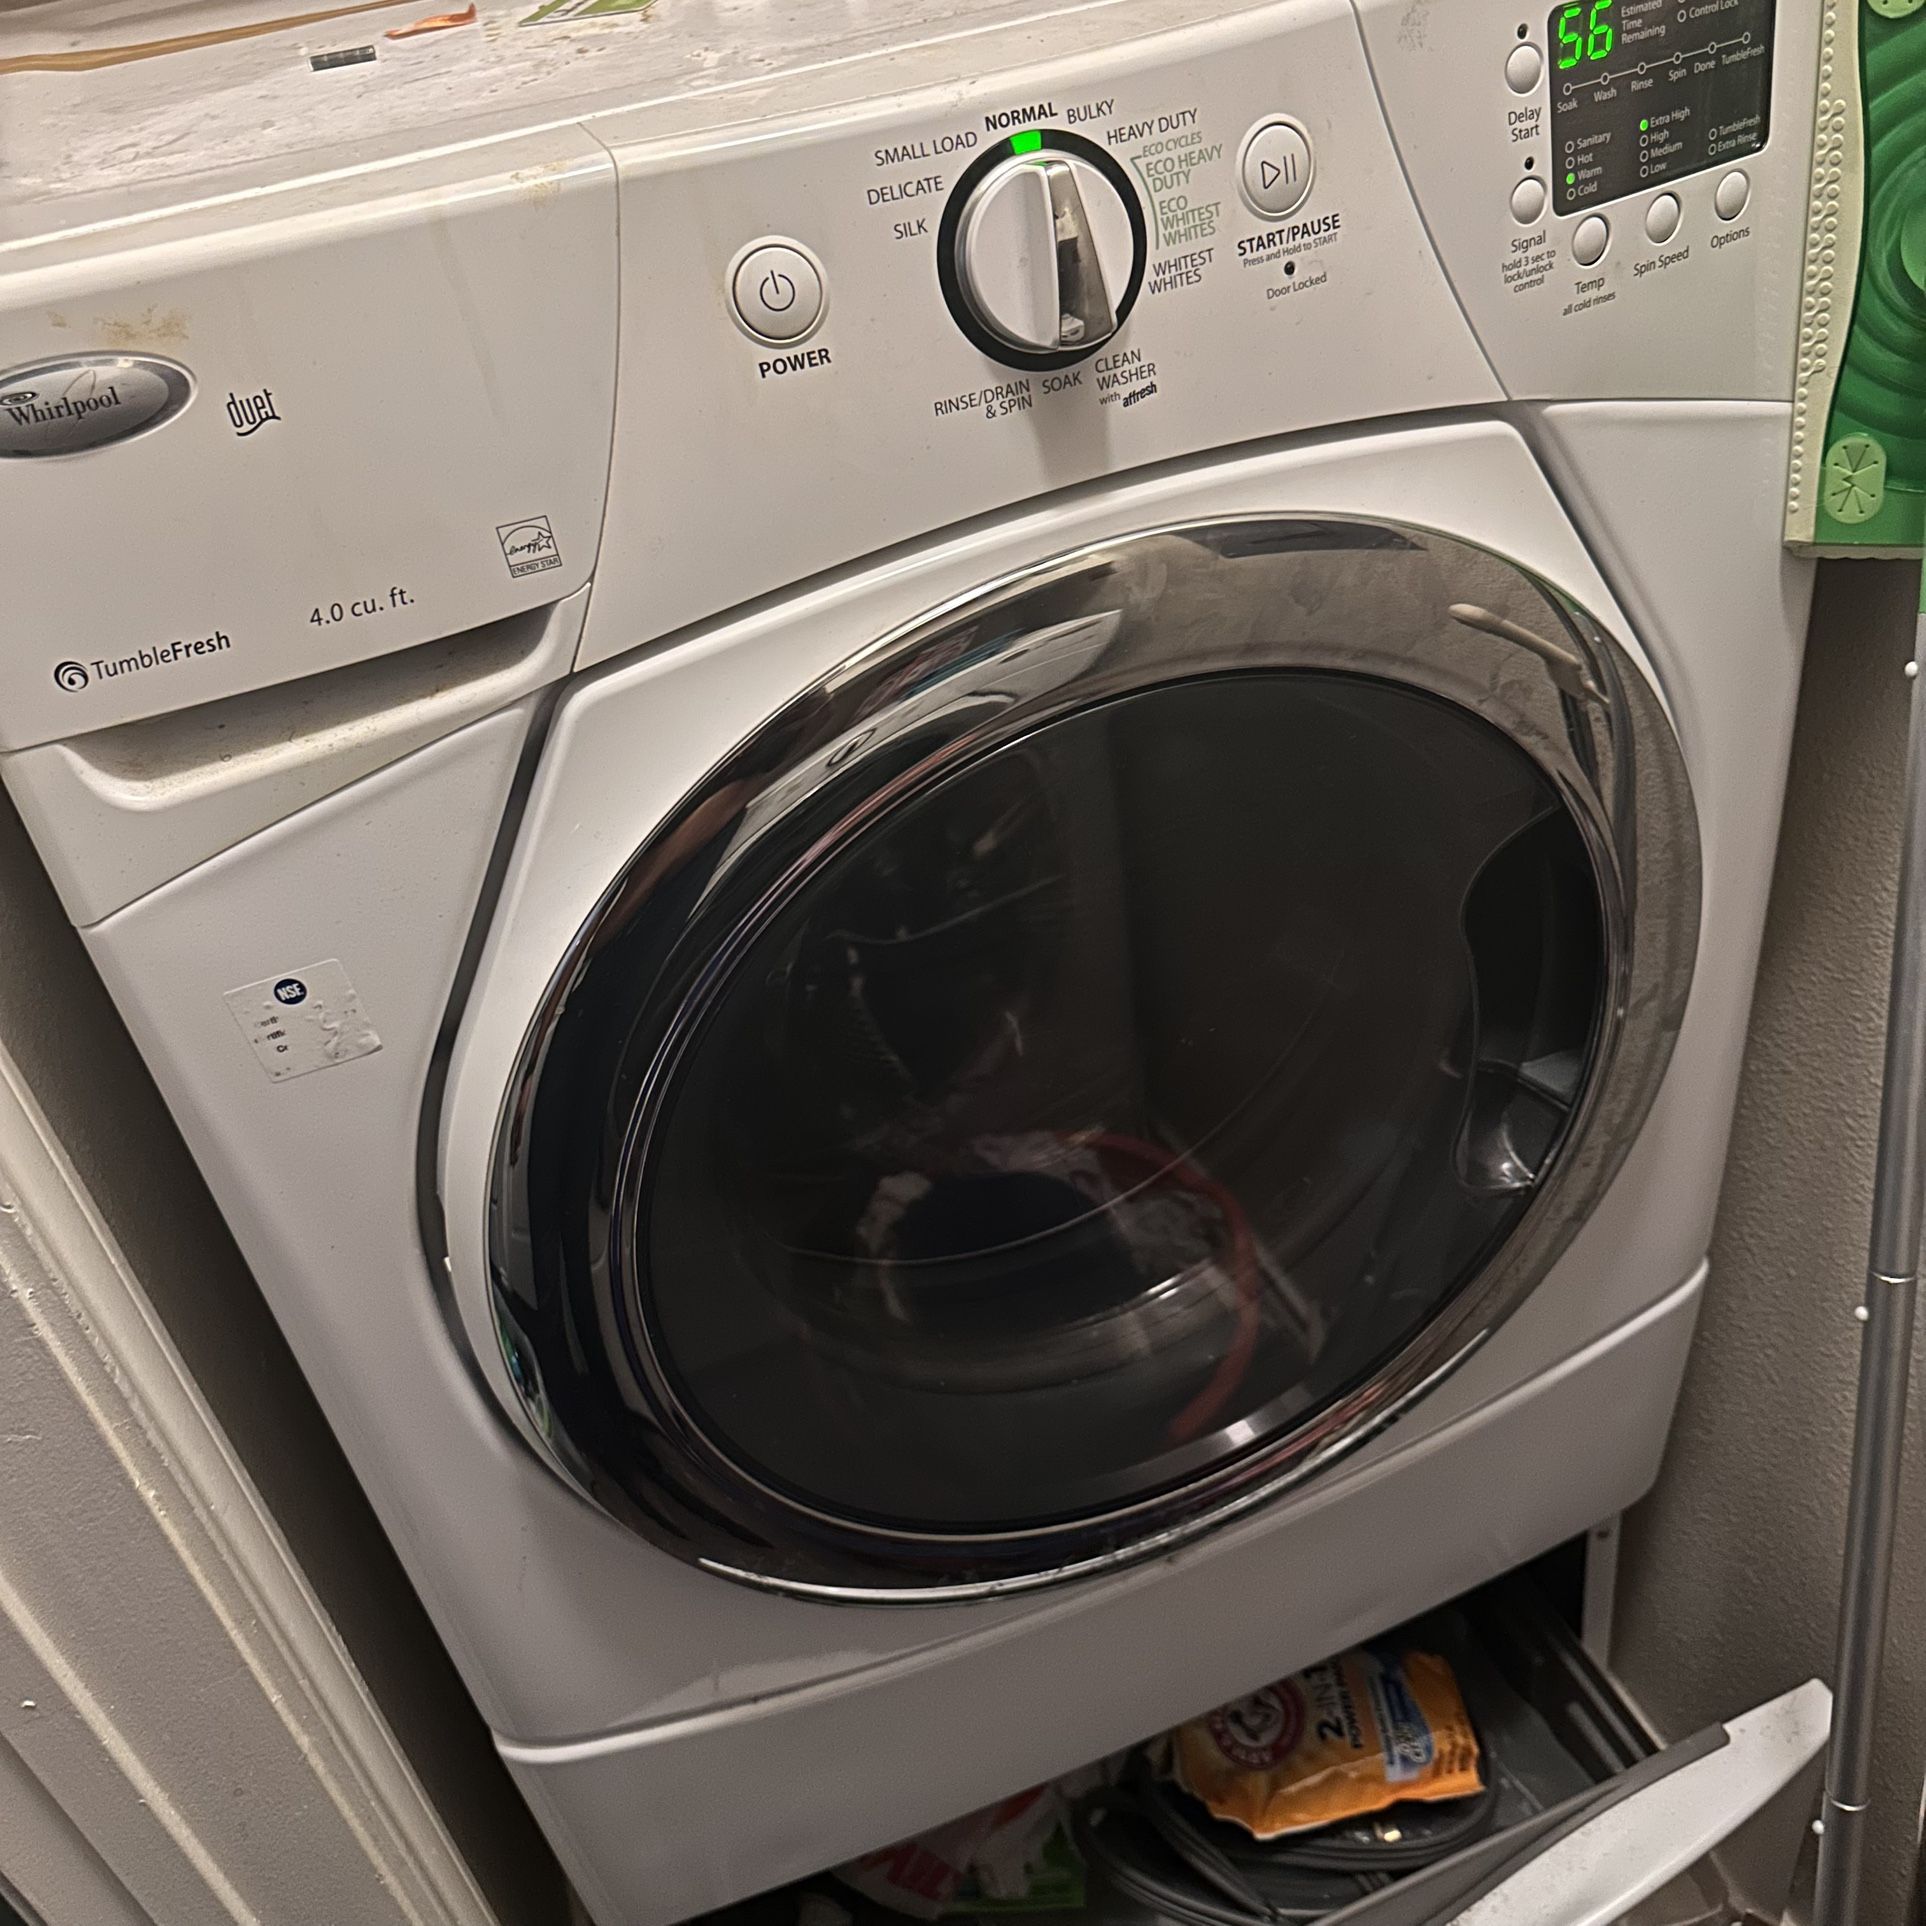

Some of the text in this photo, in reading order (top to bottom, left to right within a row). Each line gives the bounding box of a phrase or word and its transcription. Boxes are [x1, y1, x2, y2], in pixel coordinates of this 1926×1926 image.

[1621, 0, 1662, 17] Estimated
[1689, 1, 1719, 18] Control
[1557, 0, 1613, 69] 56
[1621, 25, 1666, 44] Remaining
[1622, 18, 1642, 31] Time
[1694, 60, 1715, 74] Done
[1721, 45, 1765, 65] TumbleFresh
[1631, 78, 1654, 92] Rinse
[1668, 67, 1687, 82] Spin
[1557, 100, 1578, 114] Soak
[1594, 88, 1617, 102] Wash
[985, 102, 1058, 131] NORMAL
[1067, 99, 1114, 124] BULKY
[1508, 106, 1541, 126] Delay
[1650, 107, 1690, 128] Extra High
[1107, 108, 1197, 145] HEAVY DUTY
[1511, 124, 1540, 142] Start
[1650, 129, 1669, 144] High
[875, 131, 977, 166] SMALL LOAD
[1143, 131, 1203, 158] ECO CYCLES
[1577, 131, 1612, 150] Sanitary
[1650, 140, 1683, 159] Medium
[1718, 132, 1757, 152] Extra Rinse
[1146, 144, 1222, 177] ECO HEAVY
[1577, 153, 1593, 166] Hot
[1650, 161, 1667, 175] Low
[1152, 169, 1191, 193] DUTY
[1578, 166, 1602, 181] Warm
[867, 175, 944, 205] DELICATE
[1578, 181, 1598, 197] Cold
[1159, 195, 1187, 216] ECO
[1161, 202, 1221, 231] WHITEST
[894, 218, 928, 239] SILK
[1163, 220, 1216, 247] WHITES
[1237, 213, 1341, 256] START/PAUSE
[1710, 226, 1751, 249] Options
[1243, 232, 1338, 268] Press and Hold to START
[1511, 229, 1547, 254] Signal
[1153, 248, 1214, 277] WHITEST
[1501, 249, 1557, 274] hold 3 sec to
[1503, 260, 1555, 285] lock/unlock
[1633, 245, 1690, 278] Spin Speed
[1148, 268, 1201, 295] WHITES
[1267, 271, 1327, 300] Door Locked
[1513, 275, 1545, 294] control
[1574, 276, 1605, 296] Temp
[1562, 291, 1616, 317] all cold rinses
[758, 348, 832, 379] POWER
[1095, 348, 1142, 374] CLEAN
[1042, 371, 1083, 395] SOAK
[1096, 362, 1157, 391] WASHER
[7, 386, 122, 427] Whirlpool
[934, 379, 1030, 416] RINSE/DRAIN
[985, 394, 1033, 420] & SPIN
[1098, 381, 1157, 408] with affresh
[226, 388, 281, 436] duet
[512, 557, 559, 575] ENERGY STAR
[309, 586, 415, 627] 4.0 cu. ft.
[91, 631, 231, 680] TumbleFresh
